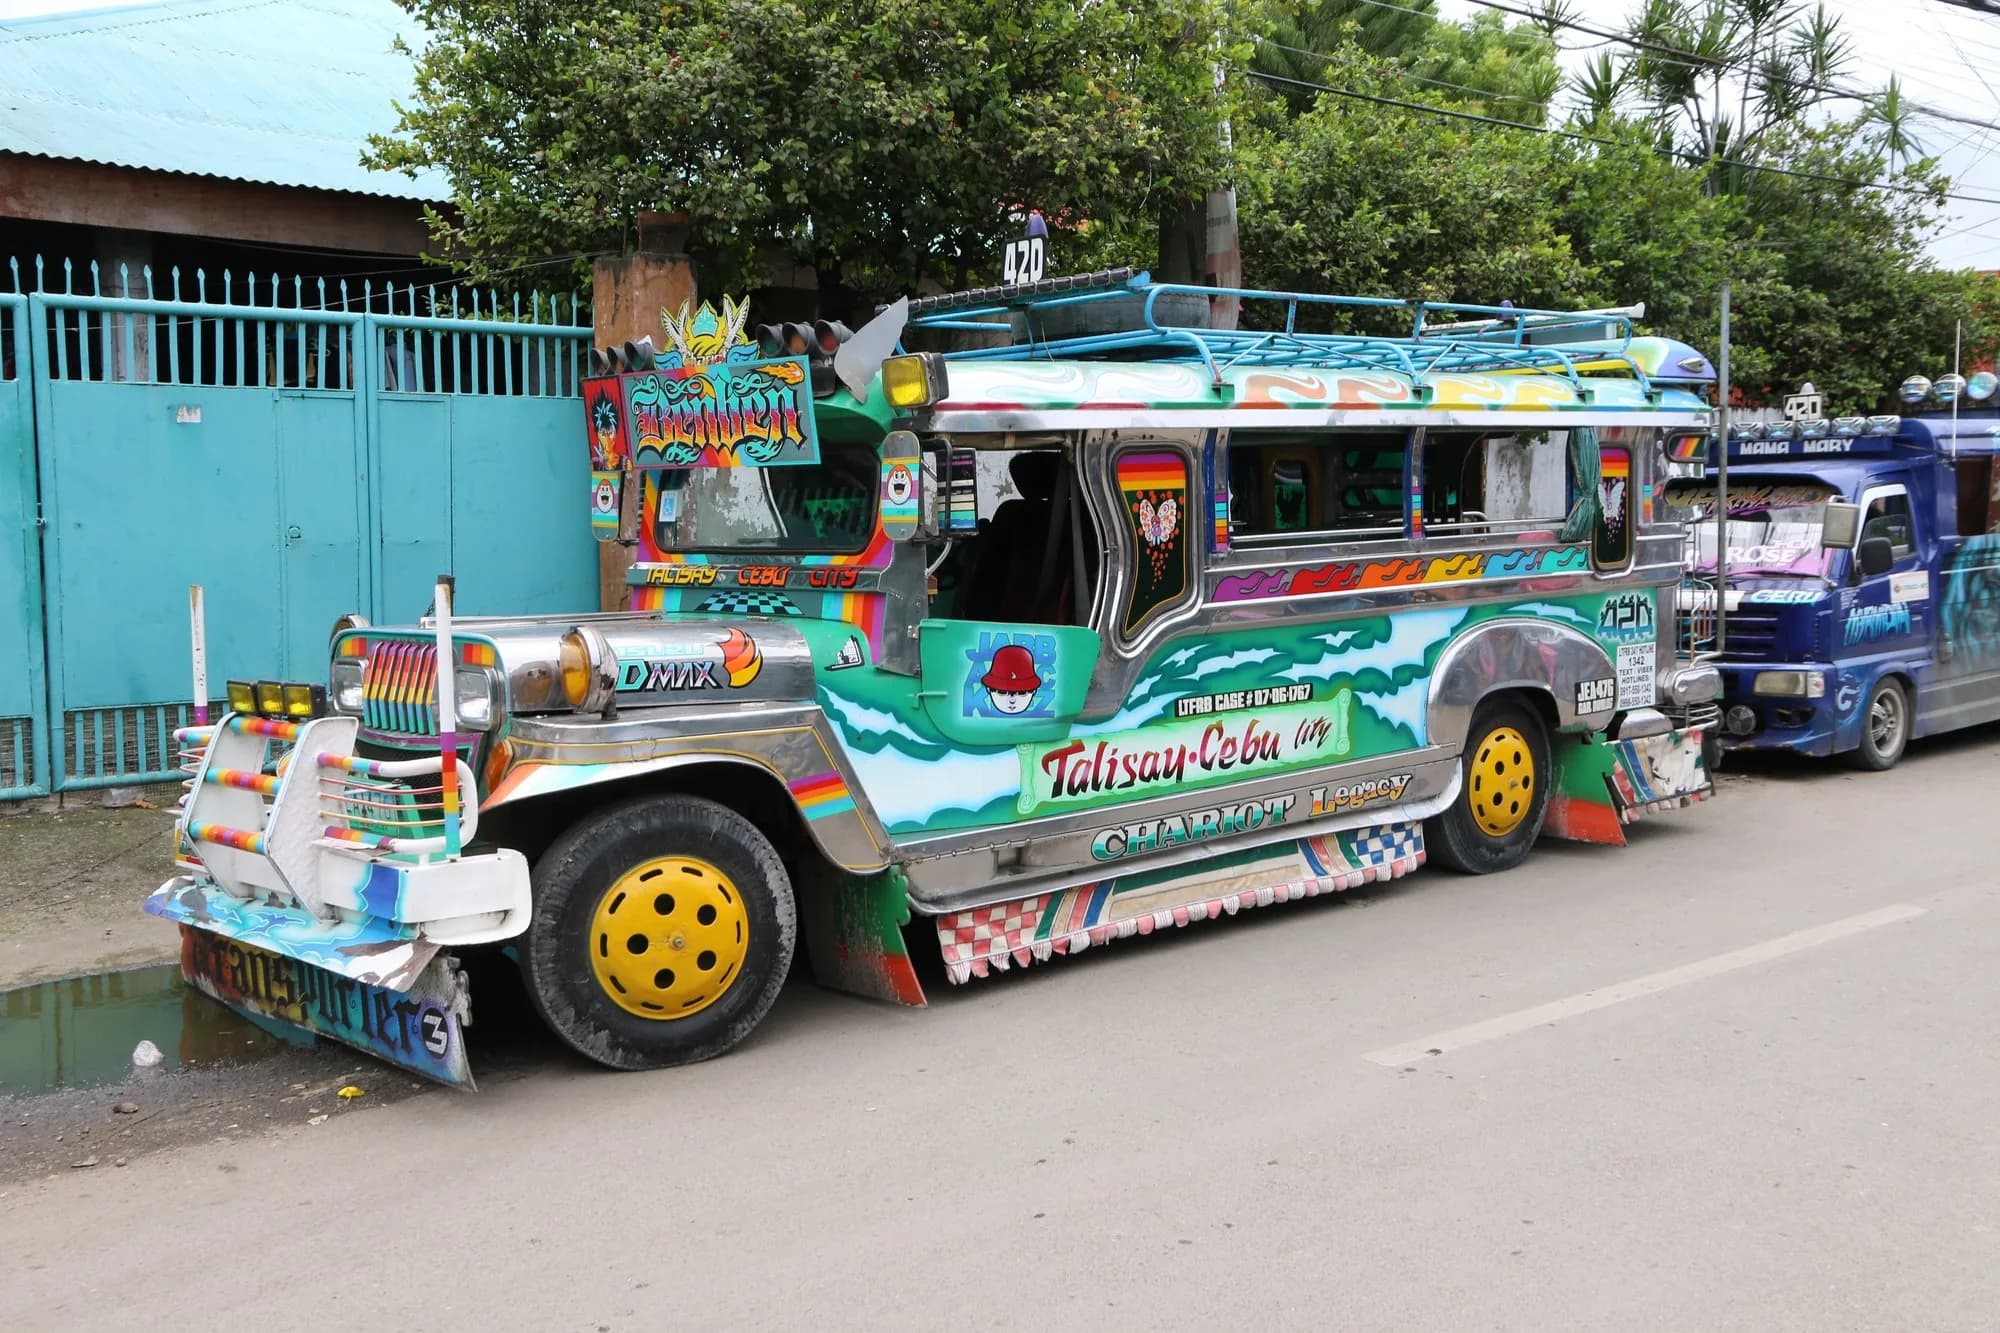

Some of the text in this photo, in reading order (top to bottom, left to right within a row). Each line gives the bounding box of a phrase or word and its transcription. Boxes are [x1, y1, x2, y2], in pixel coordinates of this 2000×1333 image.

[1004, 238, 1044, 286] 420
[1785, 397, 1821, 420] 420
[1740, 439, 1854, 455] MAMA MARY
[737, 566, 791, 587] CEBU
[809, 566, 863, 589] CITY
[1629, 655, 1645, 667] 1342
[1178, 696, 1213, 717] LTFRB
[1215, 692, 1245, 712] CASE
[1246, 691, 1253, 707] #
[1091, 773, 1413, 862] CHARIOT Legacy
